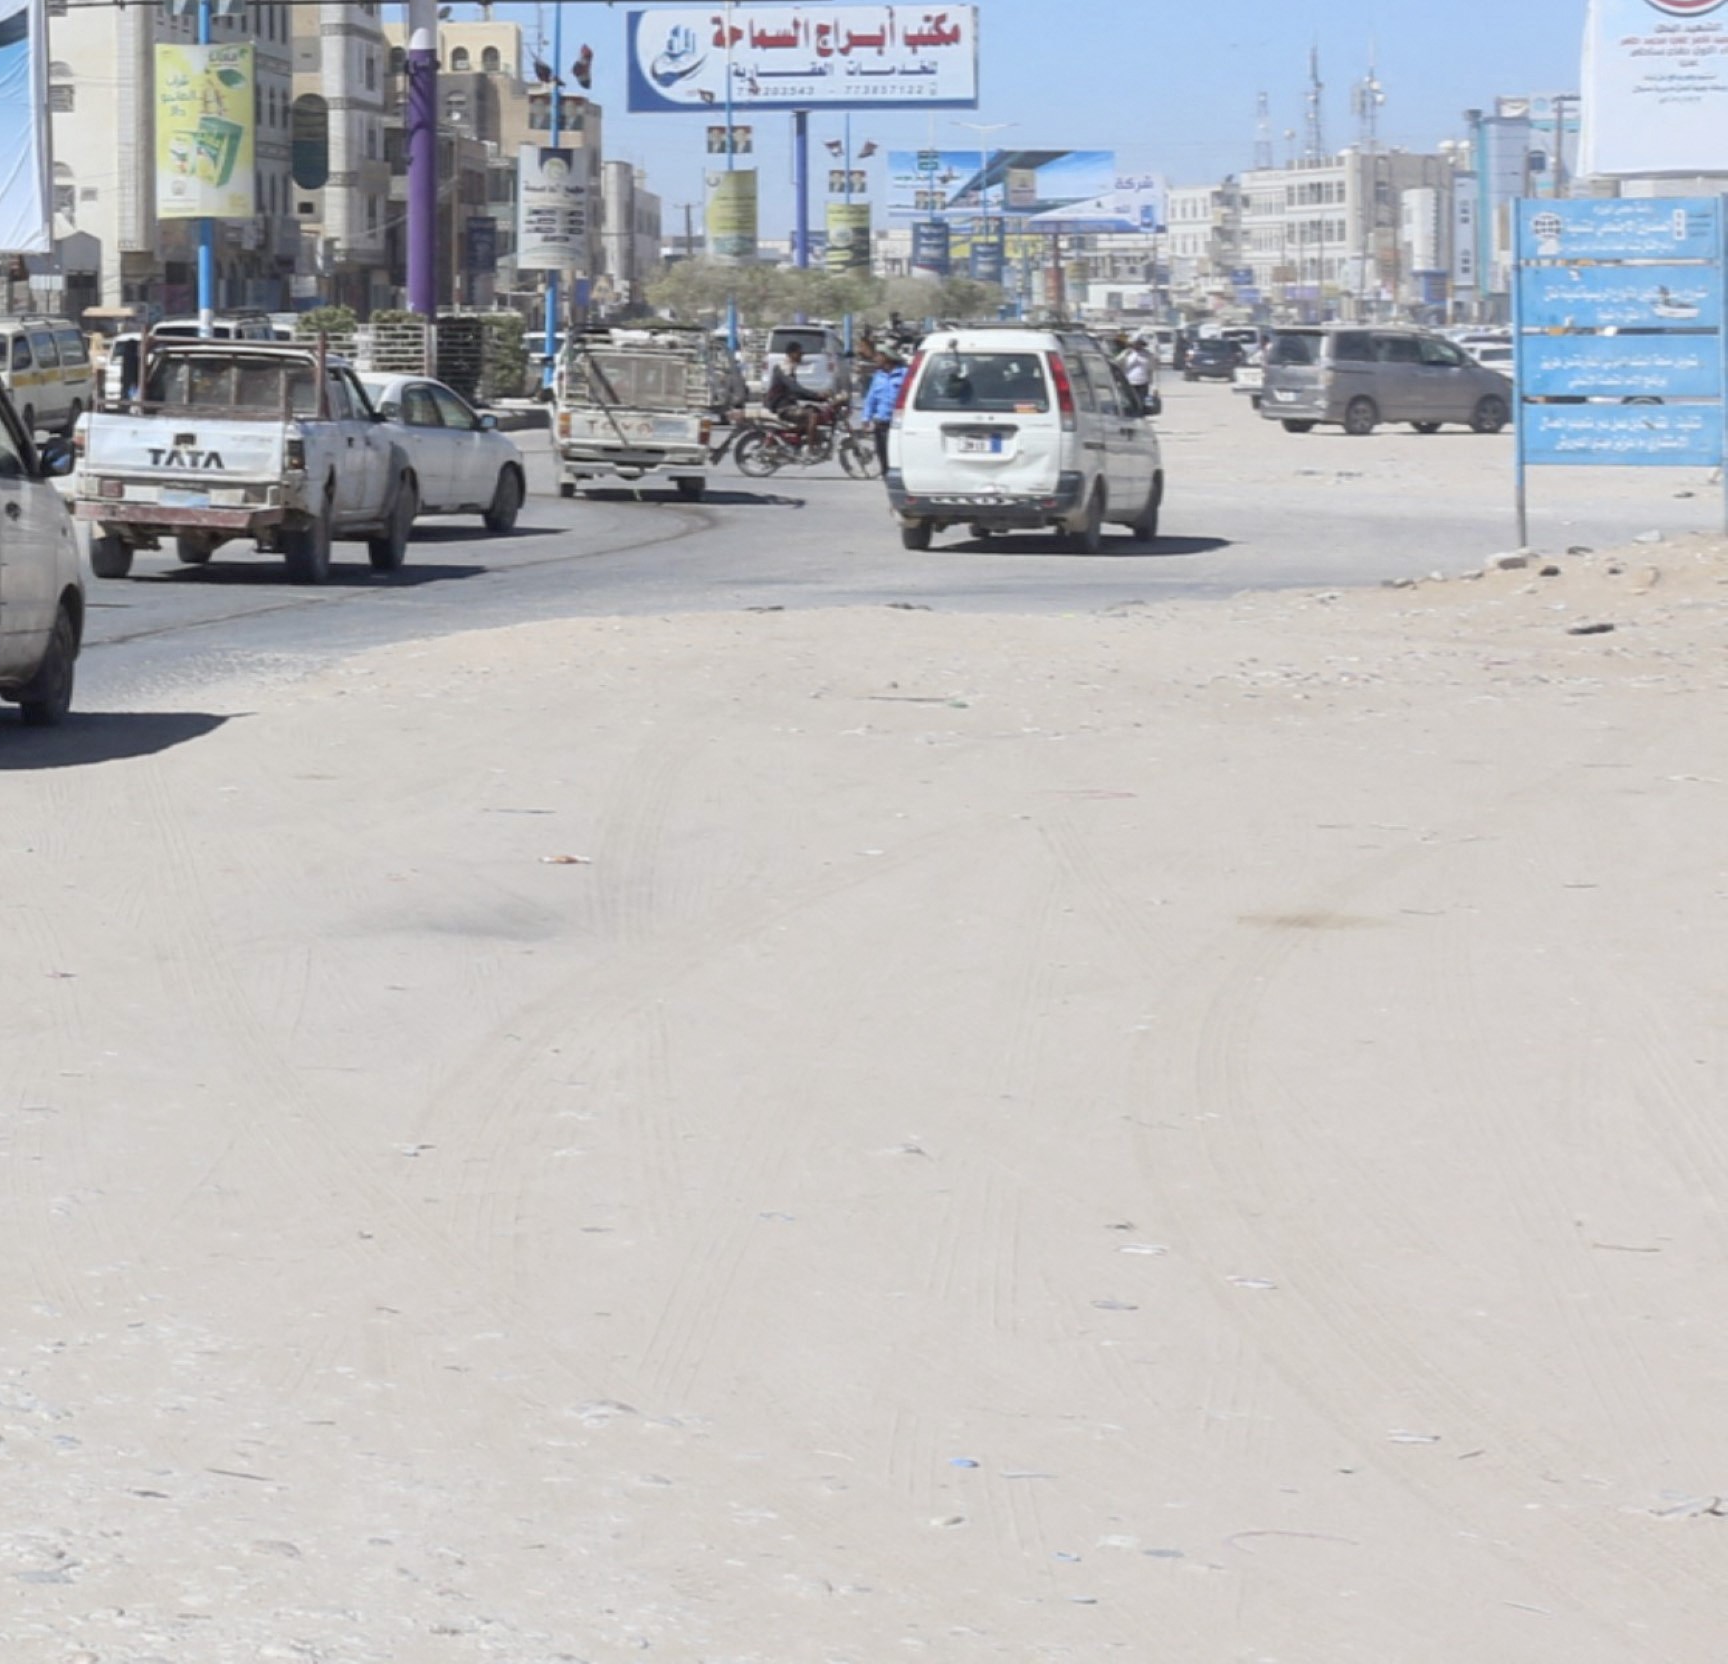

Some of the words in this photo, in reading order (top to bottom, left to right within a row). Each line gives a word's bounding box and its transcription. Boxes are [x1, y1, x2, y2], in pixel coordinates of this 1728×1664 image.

[710, 8, 809, 49] السماحة
[903, 12, 961, 55] مكتب
[148, 448, 225, 470] TATA
